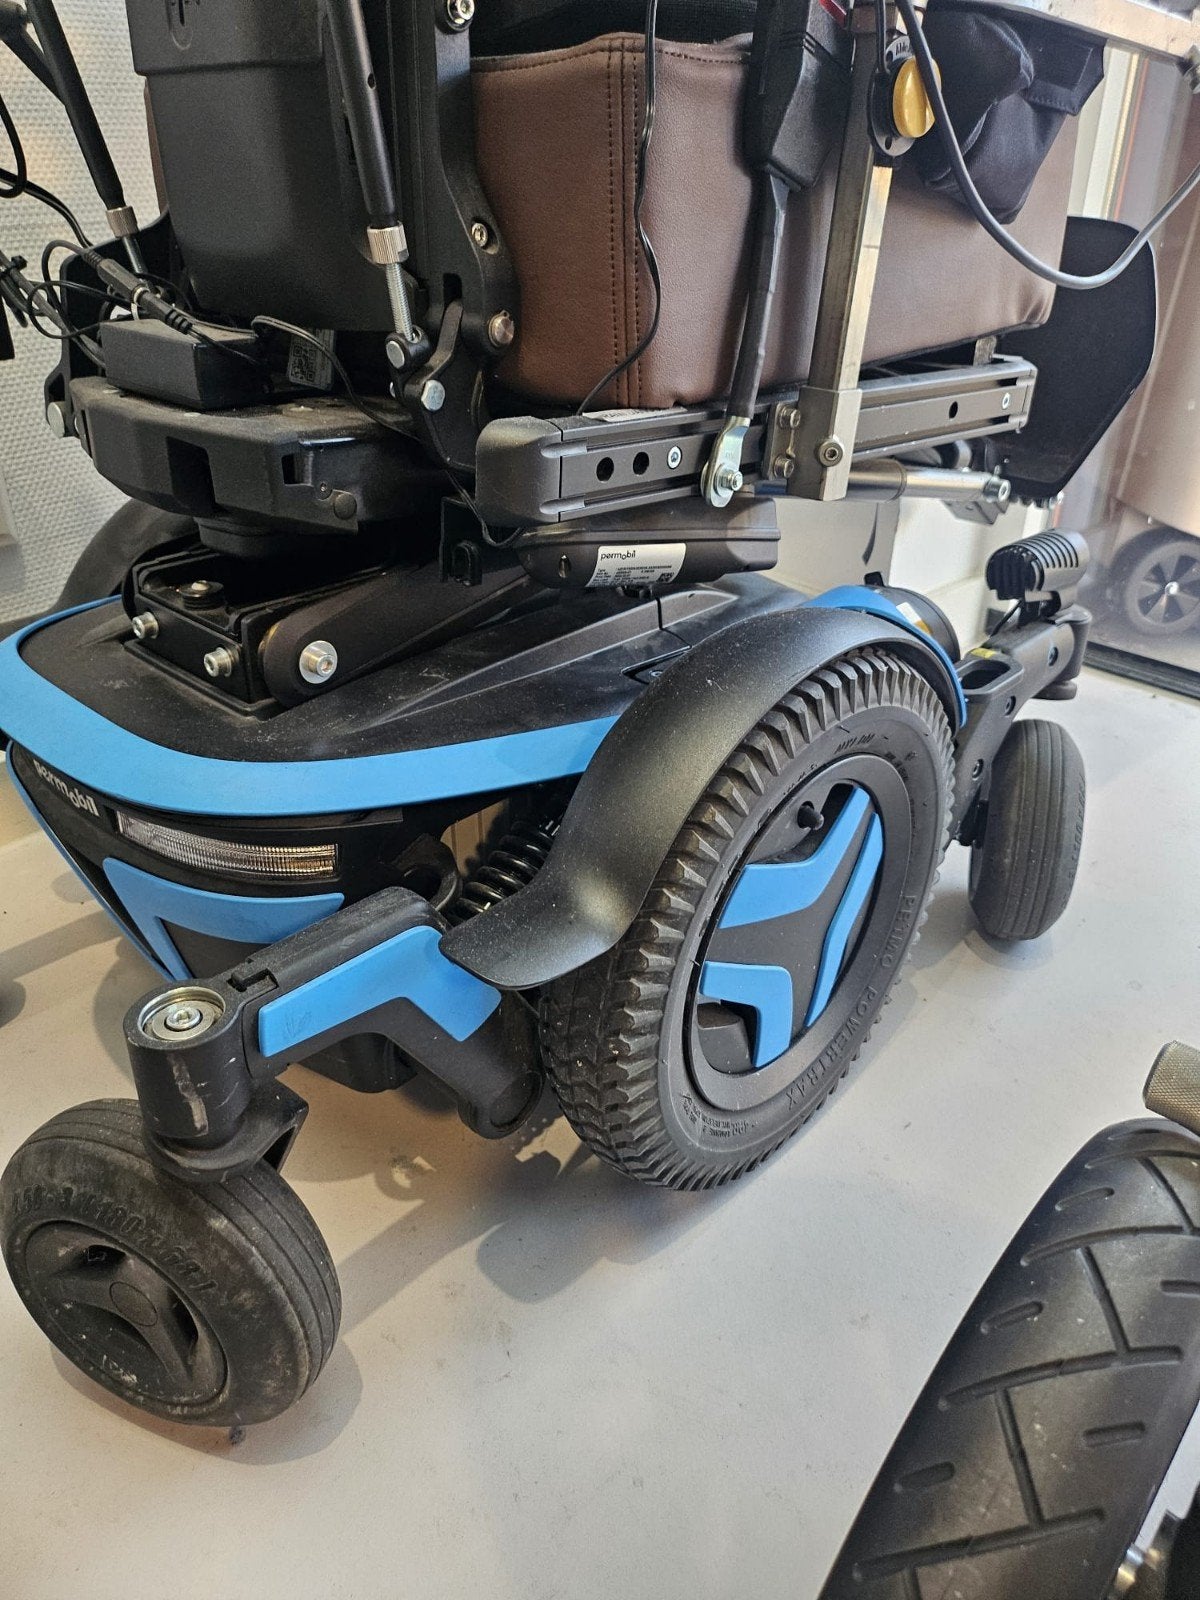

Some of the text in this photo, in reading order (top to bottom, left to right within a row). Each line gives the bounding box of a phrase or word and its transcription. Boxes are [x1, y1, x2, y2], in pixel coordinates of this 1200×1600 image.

[600, 549, 636, 561] permobil
[32, 758, 100, 817] permobil
[880, 895, 917, 968] PRIMO
